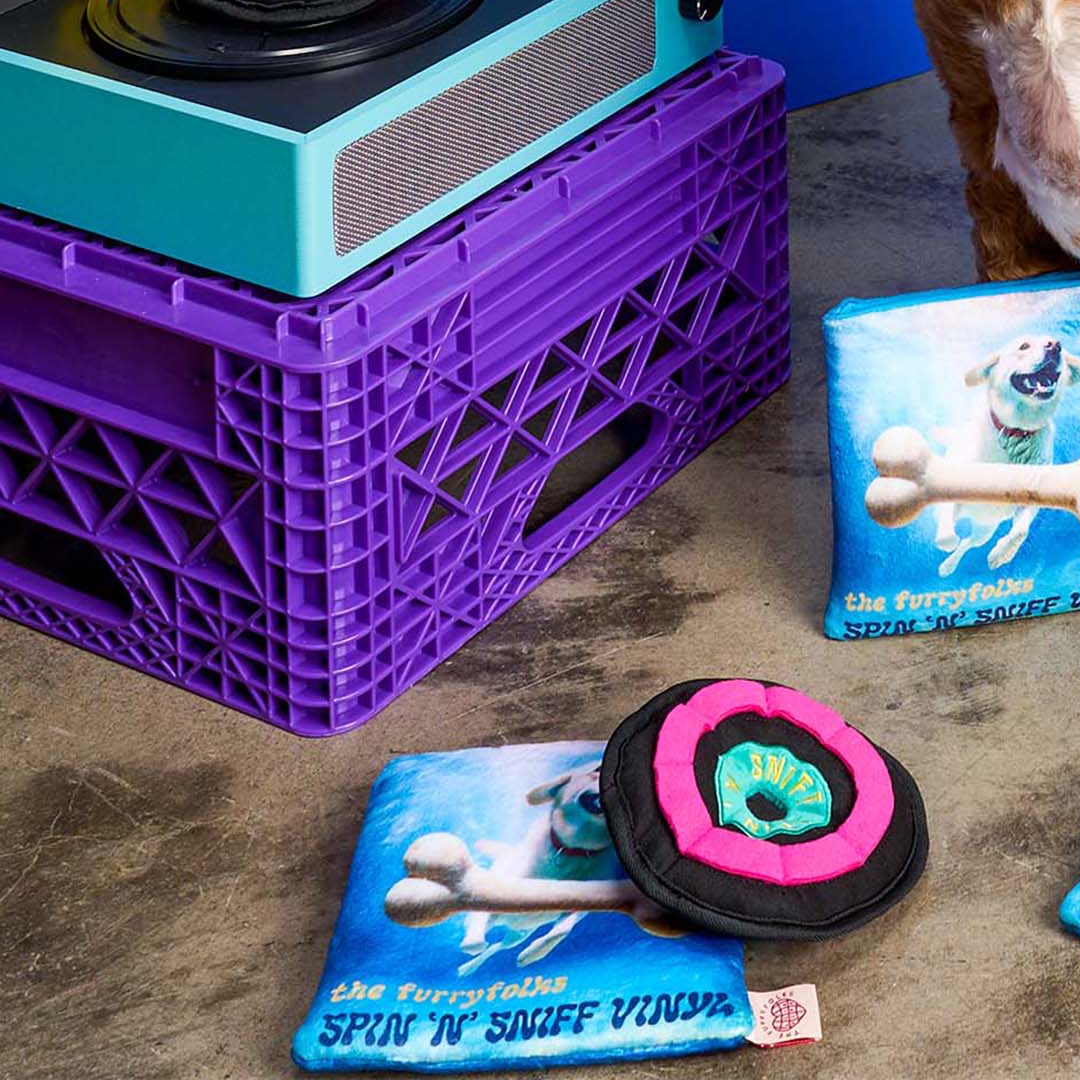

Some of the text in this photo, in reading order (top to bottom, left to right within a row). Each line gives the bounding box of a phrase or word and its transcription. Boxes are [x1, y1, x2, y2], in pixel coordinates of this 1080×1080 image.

[845, 577, 1034, 613] the furryfolks
[843, 619, 917, 640] SPIN
[975, 594, 1060, 626] SNIFF
[330, 976, 569, 1009] the furryfolks
[319, 1012, 418, 1047] SPIN
[485, 1000, 599, 1044] SNIFF
[611, 991, 736, 1031] VINYL
